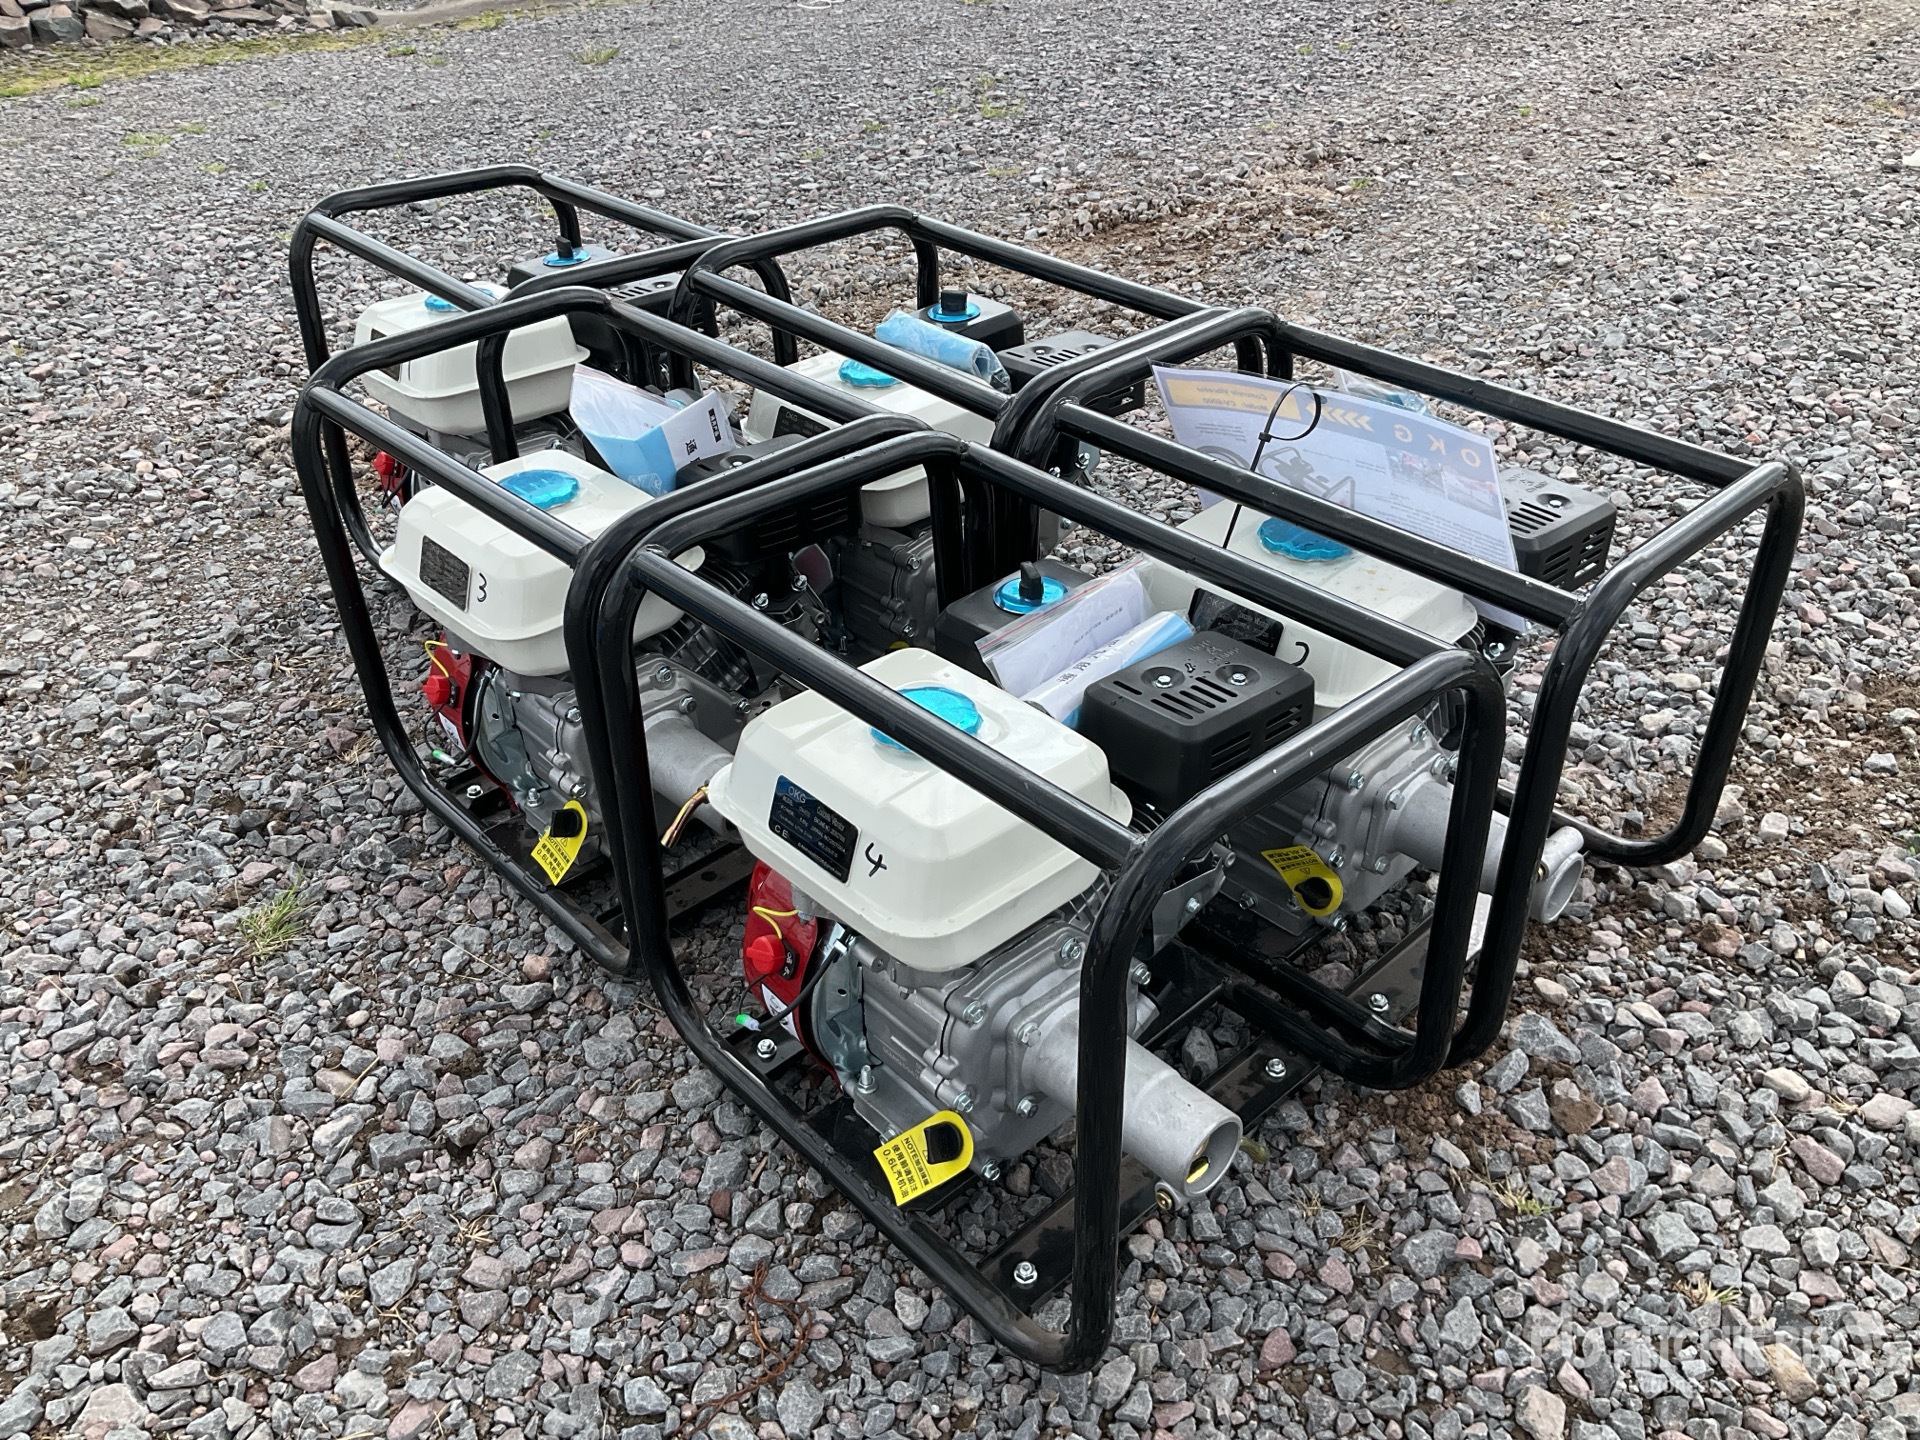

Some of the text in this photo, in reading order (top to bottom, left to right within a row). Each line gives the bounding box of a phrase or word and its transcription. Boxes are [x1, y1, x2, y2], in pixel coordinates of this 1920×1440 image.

[476, 571, 488, 603] 3
[788, 785, 806, 804] OKG
[864, 842, 888, 878] 4
